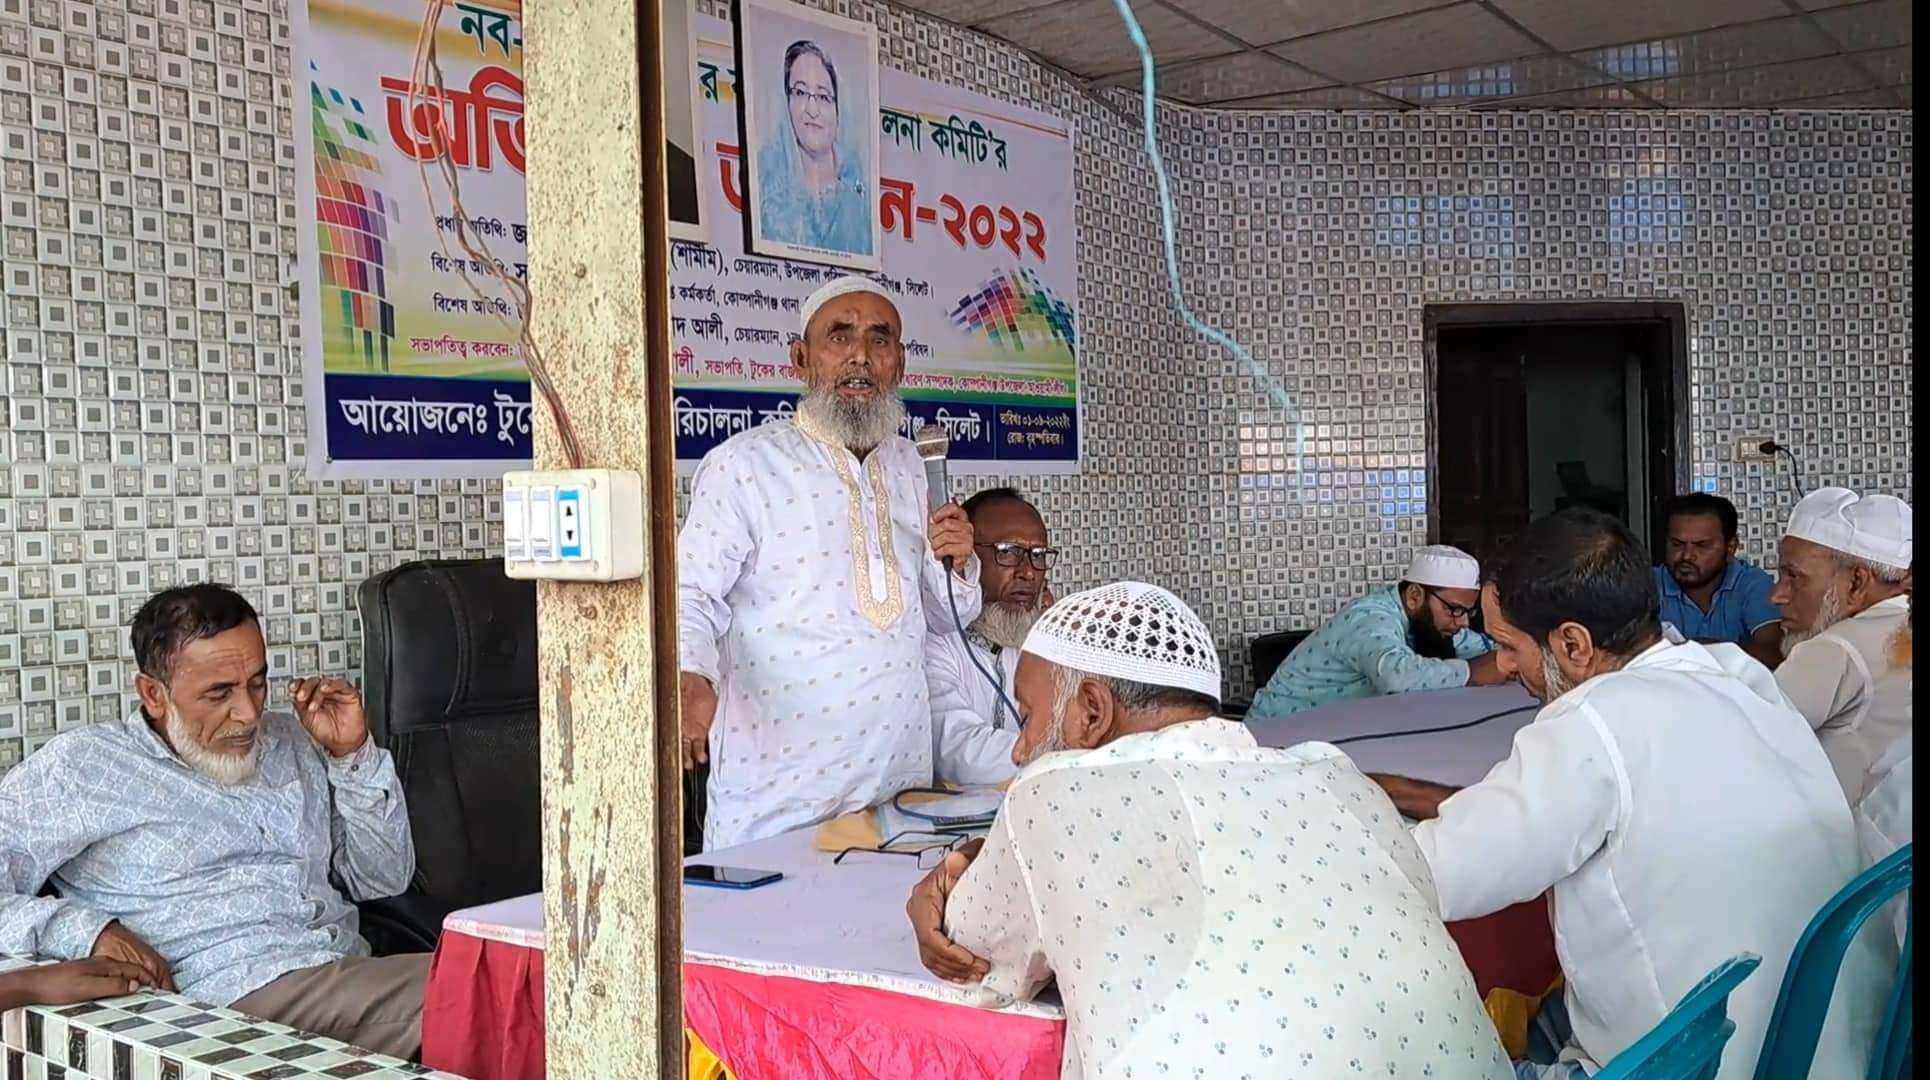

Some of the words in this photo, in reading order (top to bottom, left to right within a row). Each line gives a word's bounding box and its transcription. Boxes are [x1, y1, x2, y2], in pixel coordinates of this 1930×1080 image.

[879, 176, 1048, 264] ন-২০২২
[433, 292, 469, 313] বিশেষ
[691, 313, 729, 344] আলী,
[674, 396, 754, 439] রিচালনা
